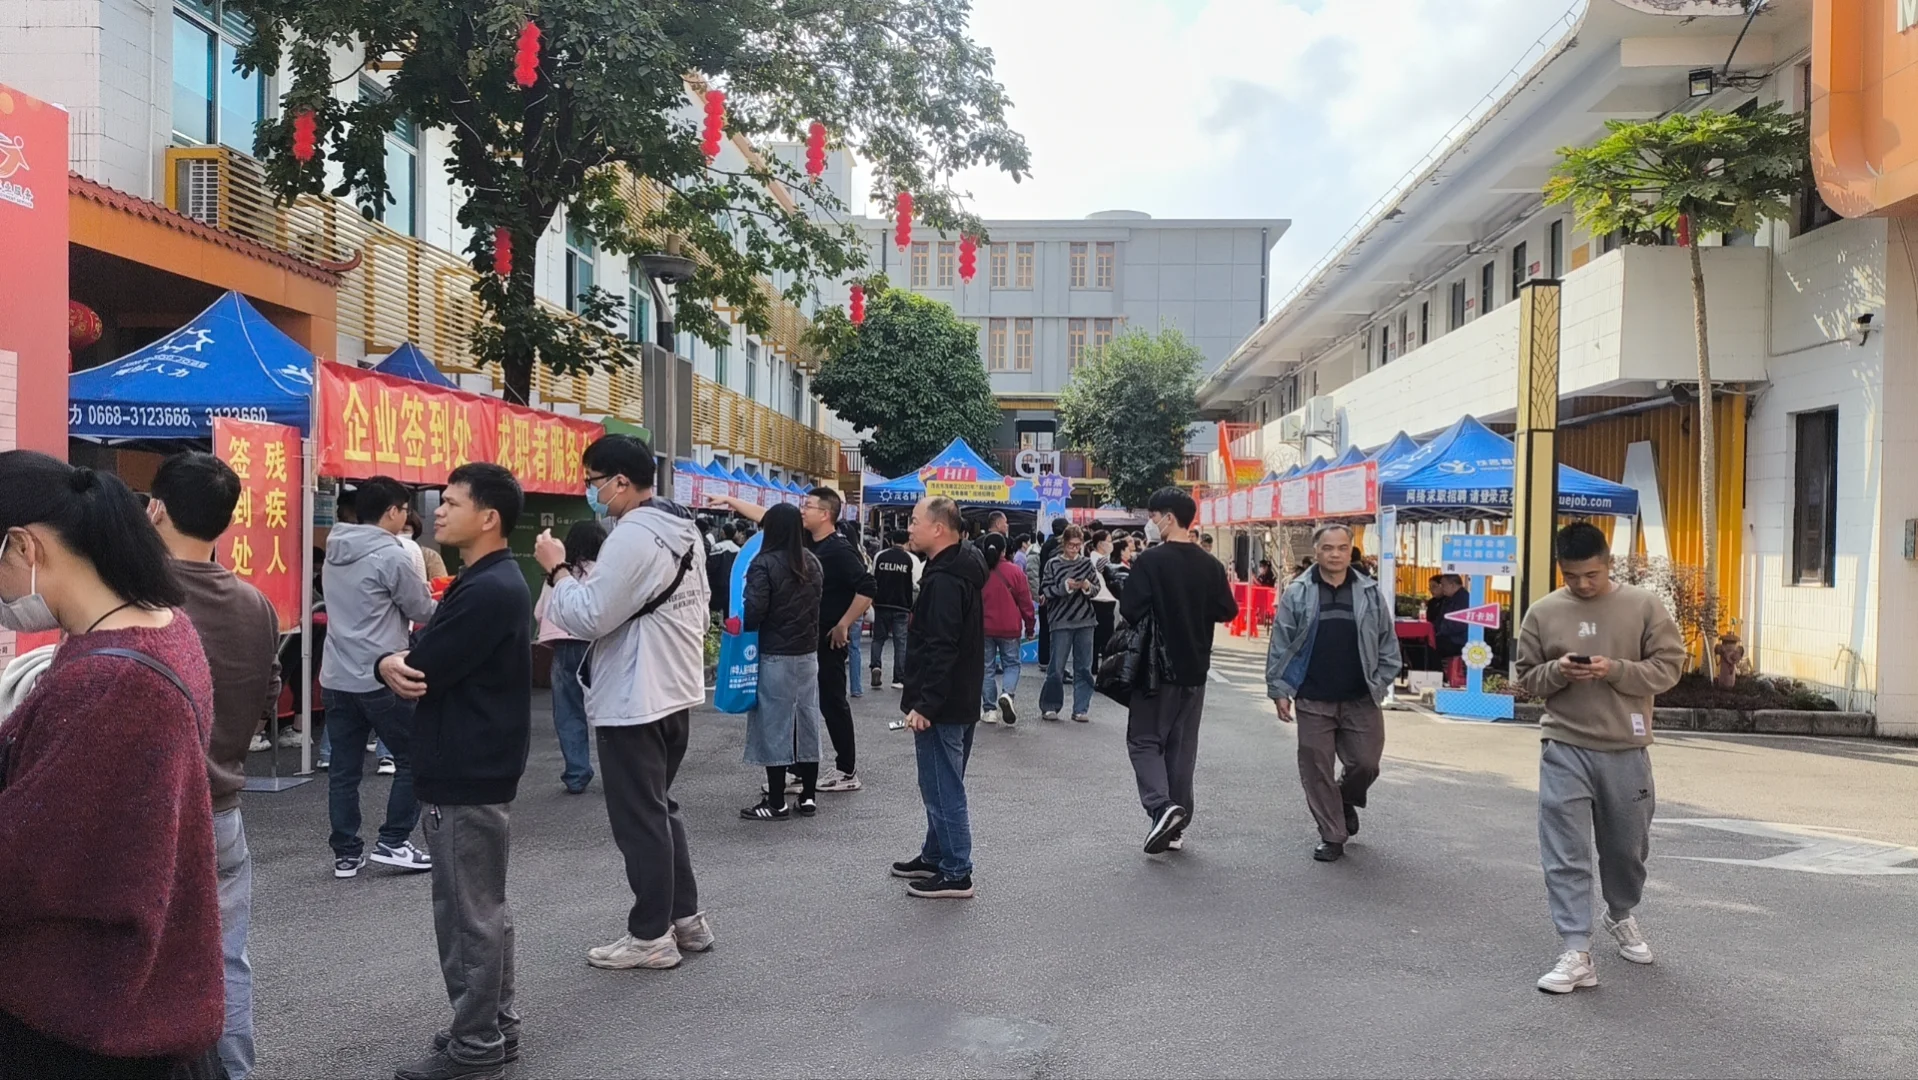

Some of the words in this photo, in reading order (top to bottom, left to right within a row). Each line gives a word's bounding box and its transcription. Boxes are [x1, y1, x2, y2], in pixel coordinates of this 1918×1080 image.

[68, 404, 82, 425] 力
[343, 383, 472, 471] 企业签到处
[943, 468, 969, 480] Hi!
[1406, 489, 1466, 504] 网络求职招聘
[1559, 494, 1612, 509] uejob.com
[229, 436, 253, 576] 签到处
[264, 441, 288, 575] 残疾人
[879, 562, 908, 573] CELINE
[1501, 565, 1510, 573] 北
